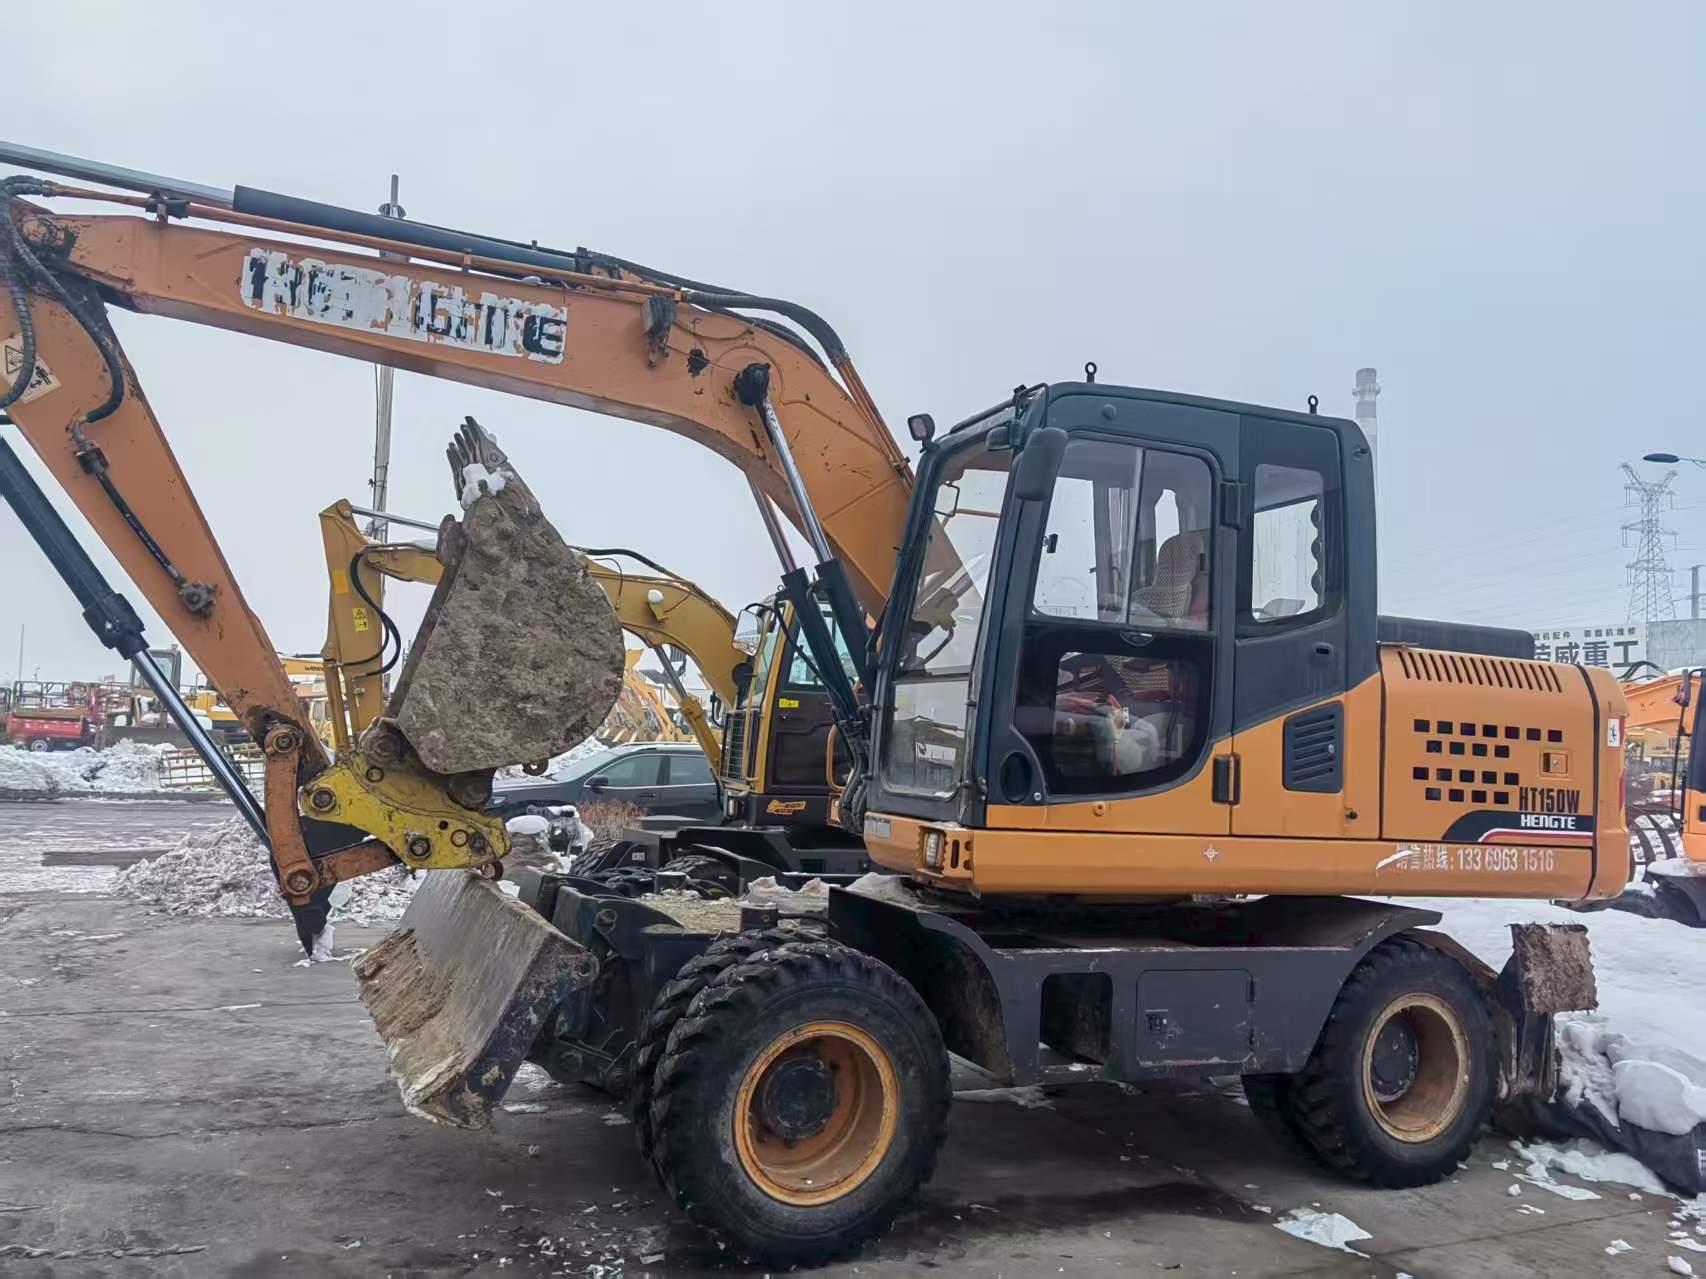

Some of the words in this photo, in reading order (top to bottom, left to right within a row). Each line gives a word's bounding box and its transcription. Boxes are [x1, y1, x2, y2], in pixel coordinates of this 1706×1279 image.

[1519, 786, 1580, 814] HT150W
[1520, 813, 1577, 830] HENGTE
[1457, 847, 1481, 871] 133
[1485, 848, 1518, 871] 6963
[1523, 848, 1554, 872] 1516
